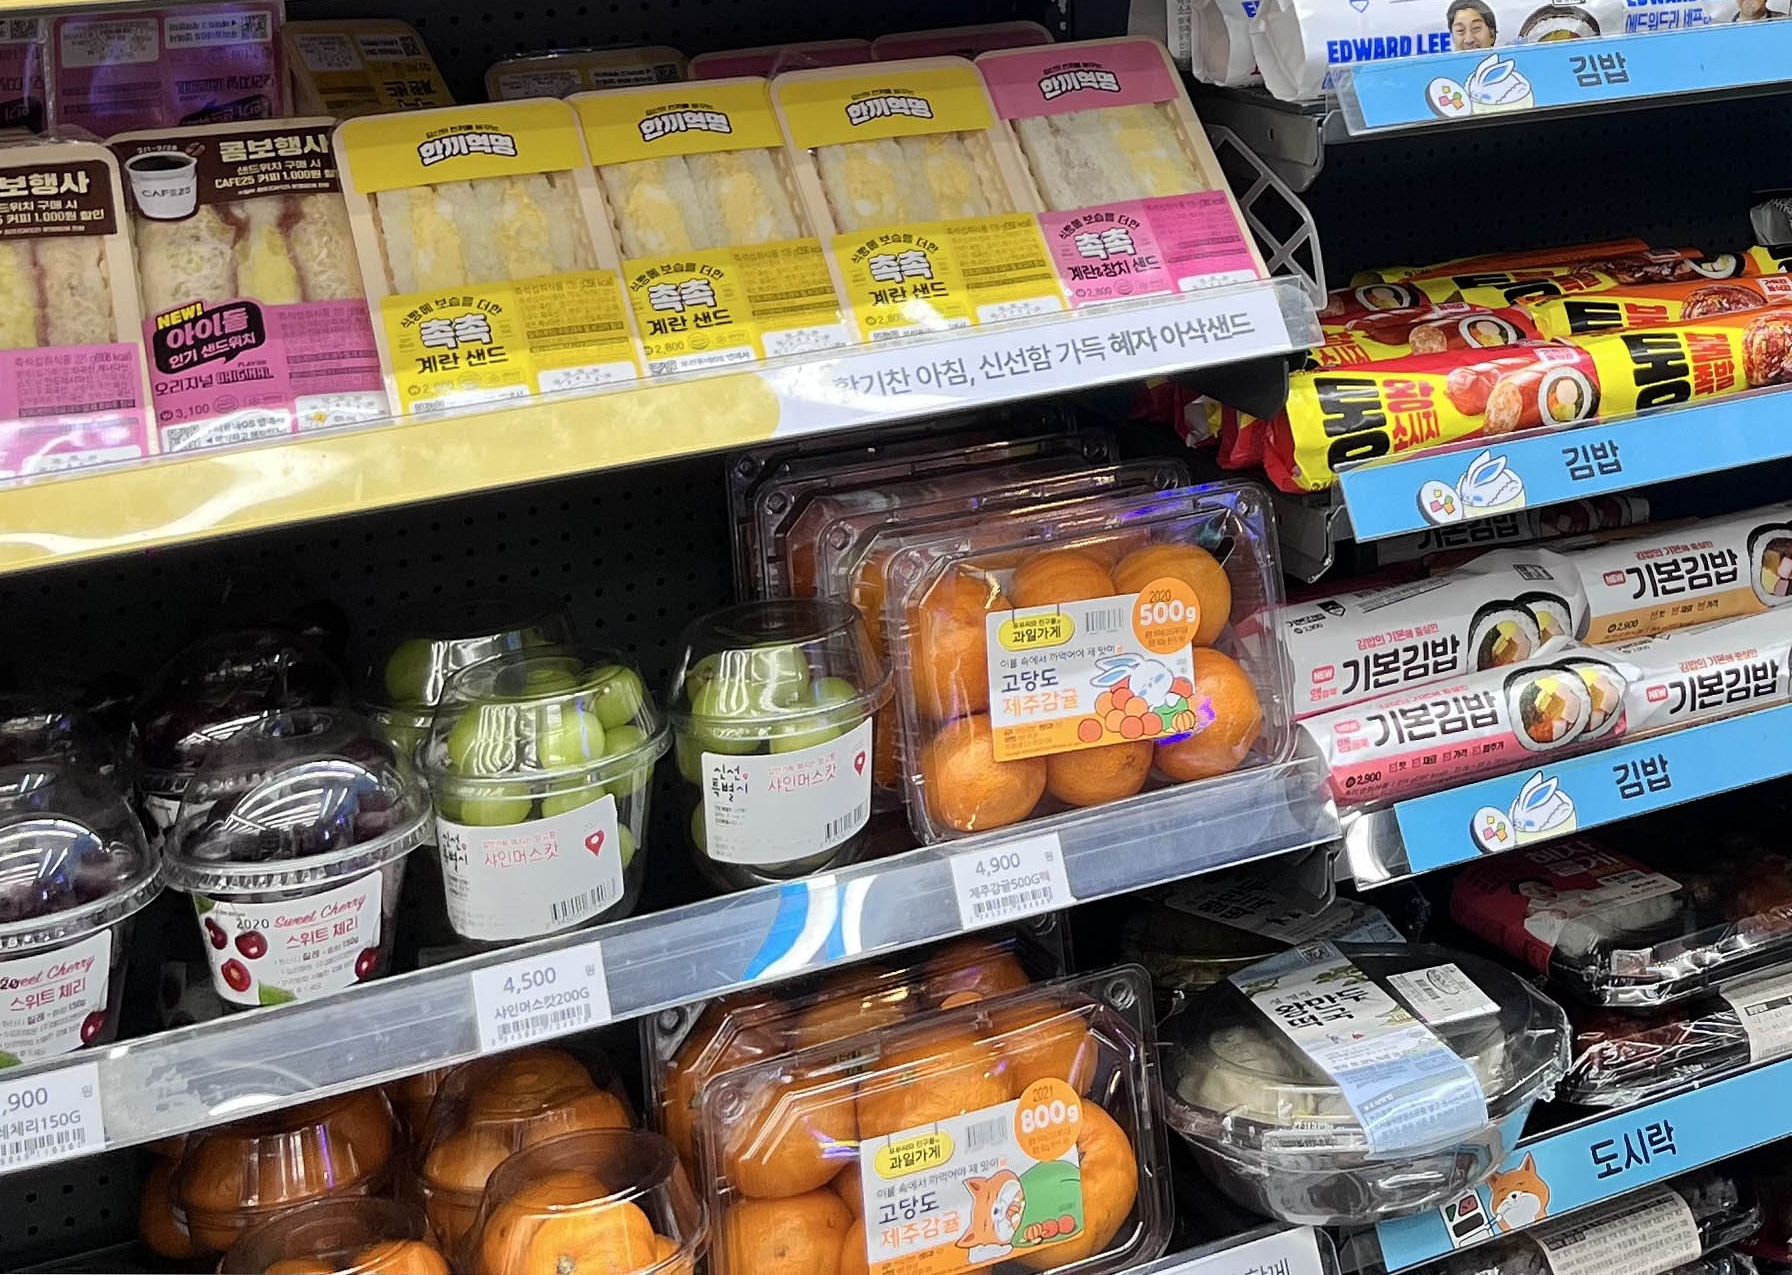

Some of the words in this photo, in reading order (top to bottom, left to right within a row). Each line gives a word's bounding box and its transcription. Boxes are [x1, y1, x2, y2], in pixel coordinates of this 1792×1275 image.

[1328, 38, 1411, 64] EDWARD
[1416, 32, 1452, 55] LEE
[1038, 69, 1119, 97] 한끼혁명
[1569, 54, 1628, 85] 김밥
[220, 135, 329, 163] 콤보행사
[418, 131, 518, 167] 한끼혁명
[1074, 228, 1138, 261] 촉촉
[1132, 255, 1162, 273] 샌드
[157, 302, 203, 329] NEW!
[477, 297, 503, 316] 더한
[166, 309, 251, 347] 아이돌
[419, 313, 494, 349] 촉촉
[169, 349, 198, 370] 인기
[201, 331, 257, 362] 샌드위치
[415, 351, 460, 374] 계란
[466, 345, 509, 367] 샌드
[915, 357, 977, 391] 아침,
[978, 345, 1053, 381] 신선함
[1058, 338, 1105, 369] 가득
[1110, 329, 1157, 361] 혜자
[1160, 310, 1256, 348] 아삭샌드
[154, 375, 214, 397] 오리지널
[1382, 378, 1434, 412] 왕
[175, 403, 210, 418] 3,100
[1391, 410, 1441, 452] 소시지
[1561, 442, 1623, 480] 김밥
[1625, 552, 1739, 601] 기본김밥
[1149, 589, 1172, 604] 2020
[1139, 599, 1197, 627] 500g
[1012, 625, 1062, 644] 과일가게
[1314, 667, 1334, 682] NEW
[1342, 633, 1461, 695] 기본김밥
[1001, 667, 1059, 694] 고당도
[1668, 660, 1779, 716] 기본김밥
[1003, 687, 1080, 717] 제주감귤
[1366, 691, 1500, 748] 기본김밥
[767, 766, 837, 793] 샤인머스캇
[1356, 771, 1382, 785] 2,900
[1613, 754, 1671, 800] 김밥
[975, 852, 1022, 878] 4,900
[236, 917, 270, 931] 2020
[273, 911, 316, 930] Sweet
[319, 894, 366, 925] Cherry
[285, 926, 329, 950] 스위트
[332, 917, 359, 940] 체리
[503, 966, 558, 995] 4,500
[494, 987, 590, 1021] 샤인머스캇200G
[1031, 1087, 1054, 1103] 2021
[1020, 1102, 1080, 1134] 800g
[1591, 1119, 1677, 1180] 도시락
[878, 1193, 940, 1225] 고당도
[881, 1210, 961, 1249] 제주감귤
